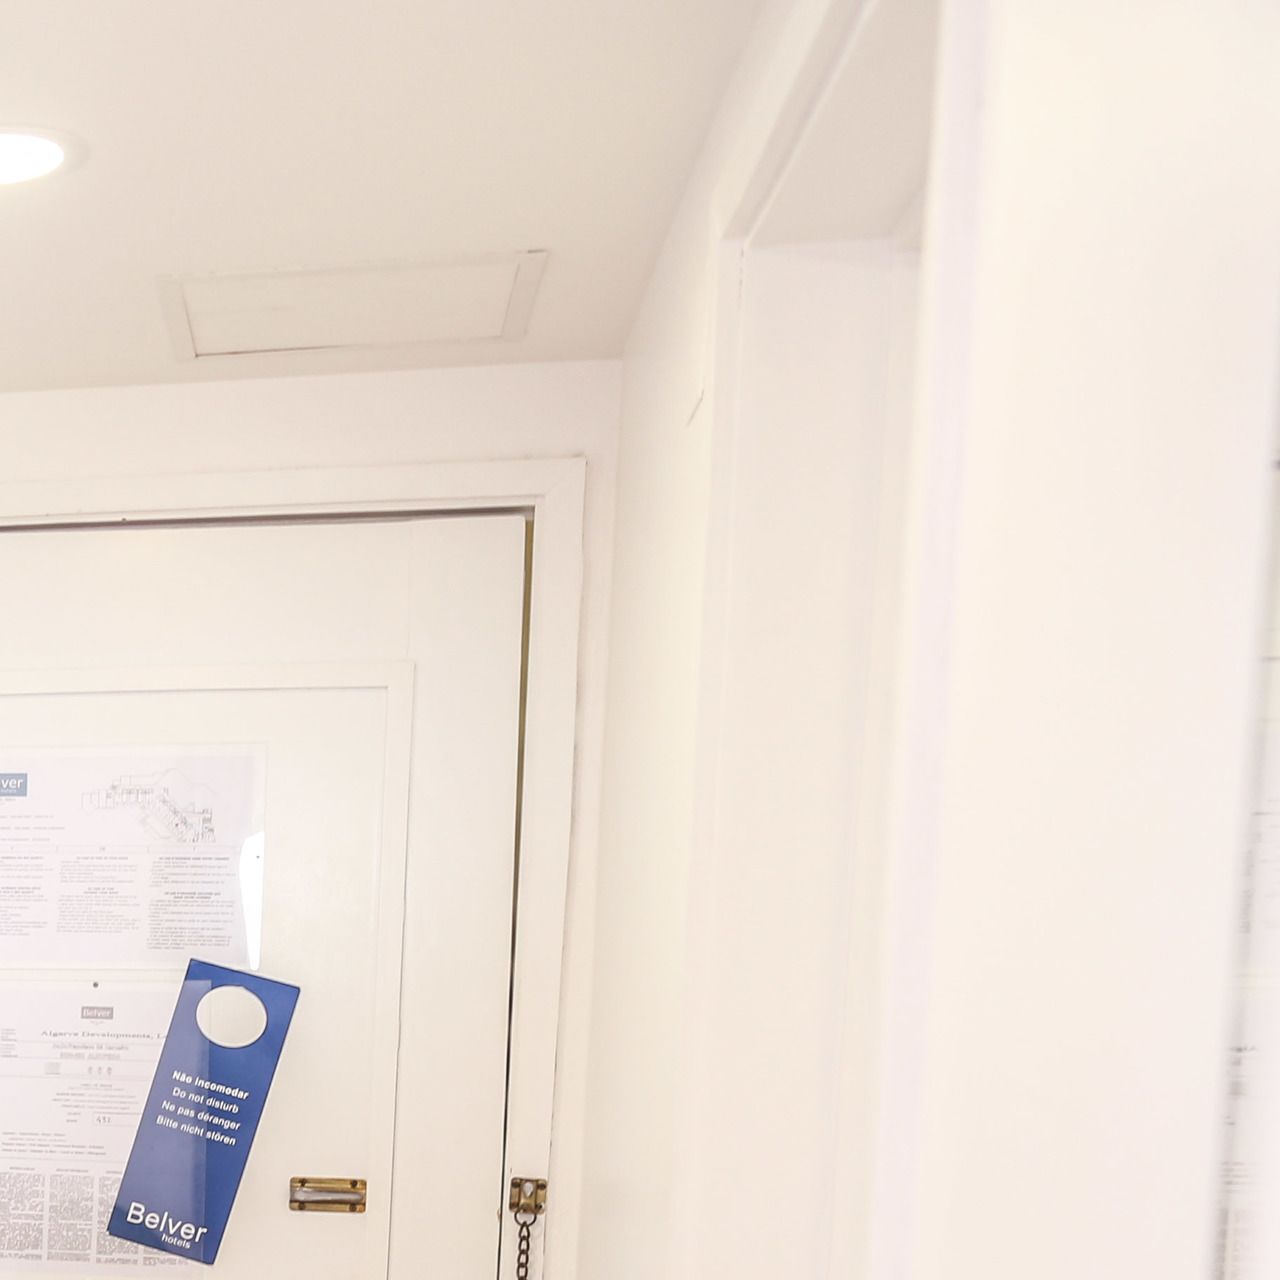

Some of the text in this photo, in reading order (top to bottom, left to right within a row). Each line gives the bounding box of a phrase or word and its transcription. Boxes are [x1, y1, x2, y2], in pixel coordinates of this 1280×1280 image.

[173, 1071, 192, 1083] Não
[161, 1100, 241, 1131] Ne pas déranger
[172, 1086, 240, 1115] Do not disturb
[156, 1114, 236, 1146] Bitte nicht stören
[126, 1201, 209, 1243] Belver
[161, 1233, 191, 1249] hotels
